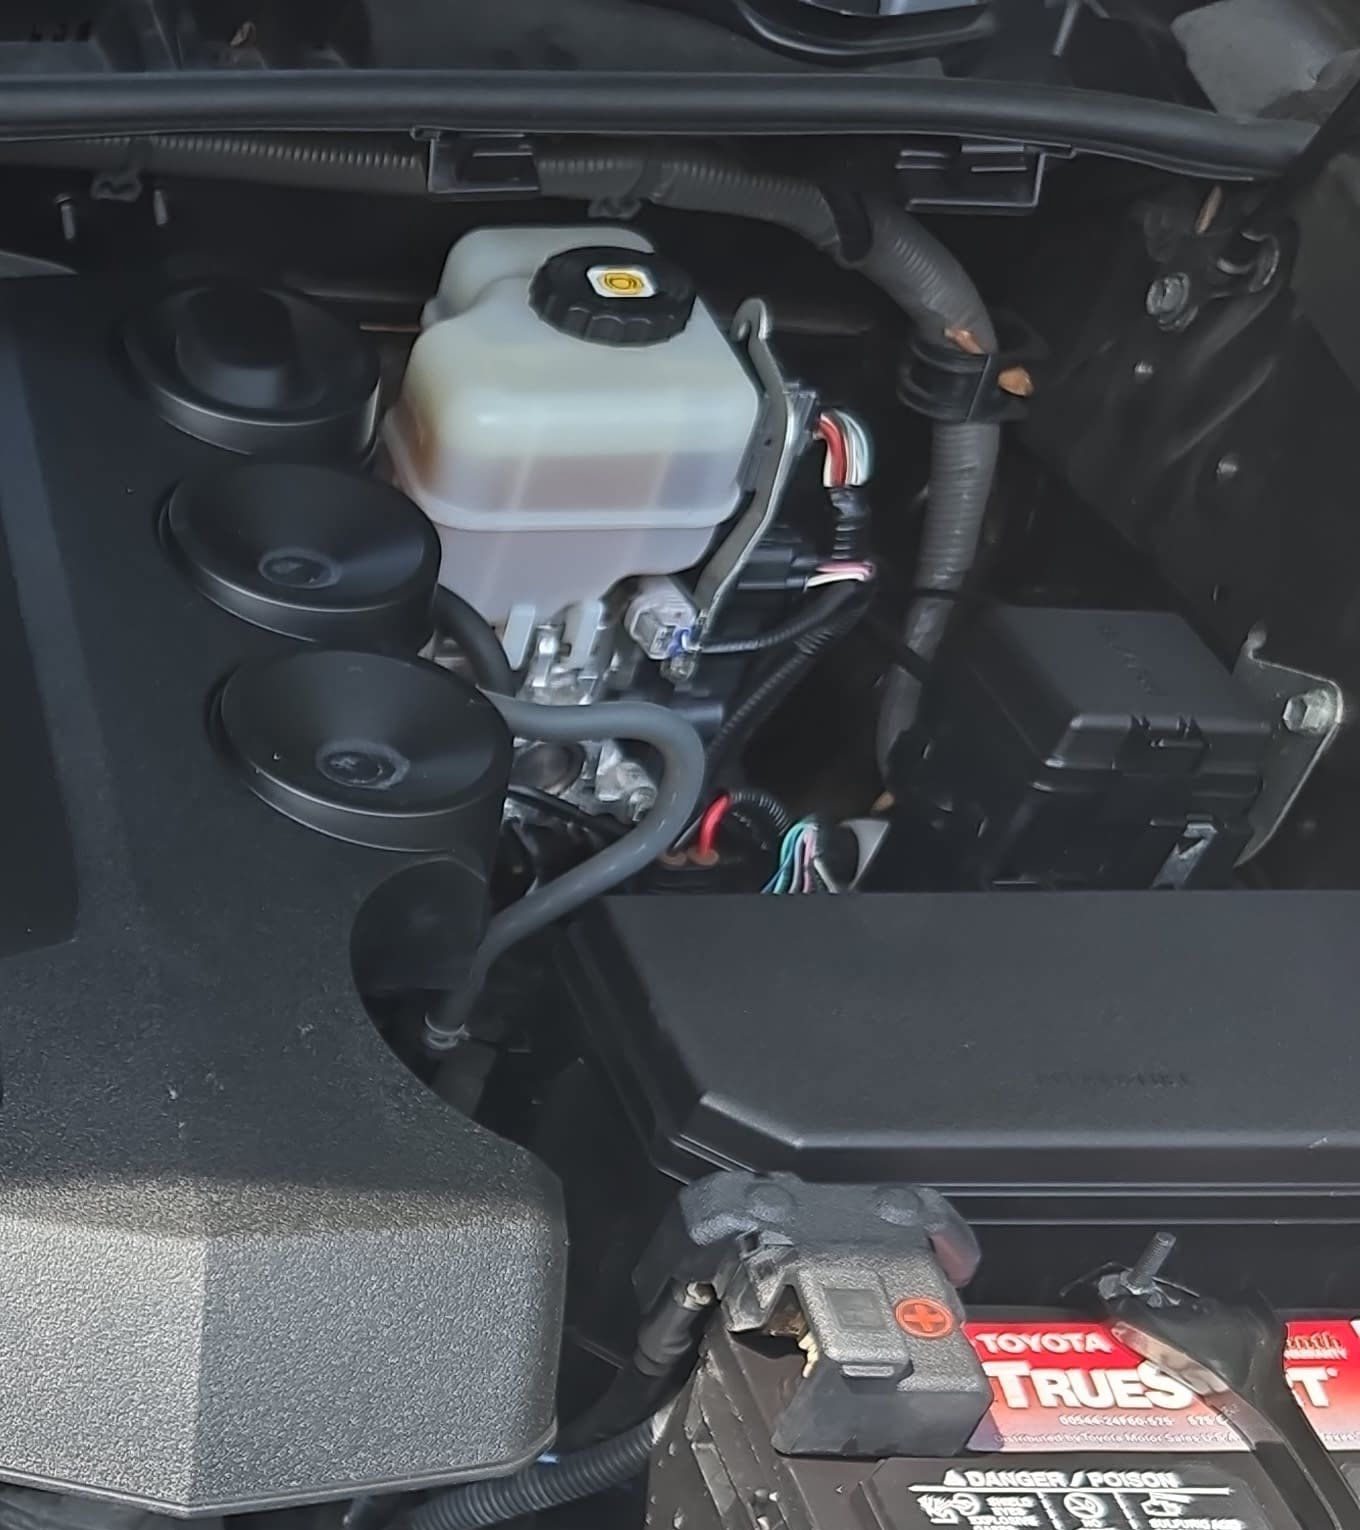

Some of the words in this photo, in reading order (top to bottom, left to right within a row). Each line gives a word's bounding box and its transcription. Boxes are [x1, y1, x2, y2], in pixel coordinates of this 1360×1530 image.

[975, 1332, 1112, 1354] TOYOTA
[982, 1360, 1194, 1410] TRUES
[963, 1471, 1068, 1488] DANGER
[1088, 1471, 1182, 1488] POISON
